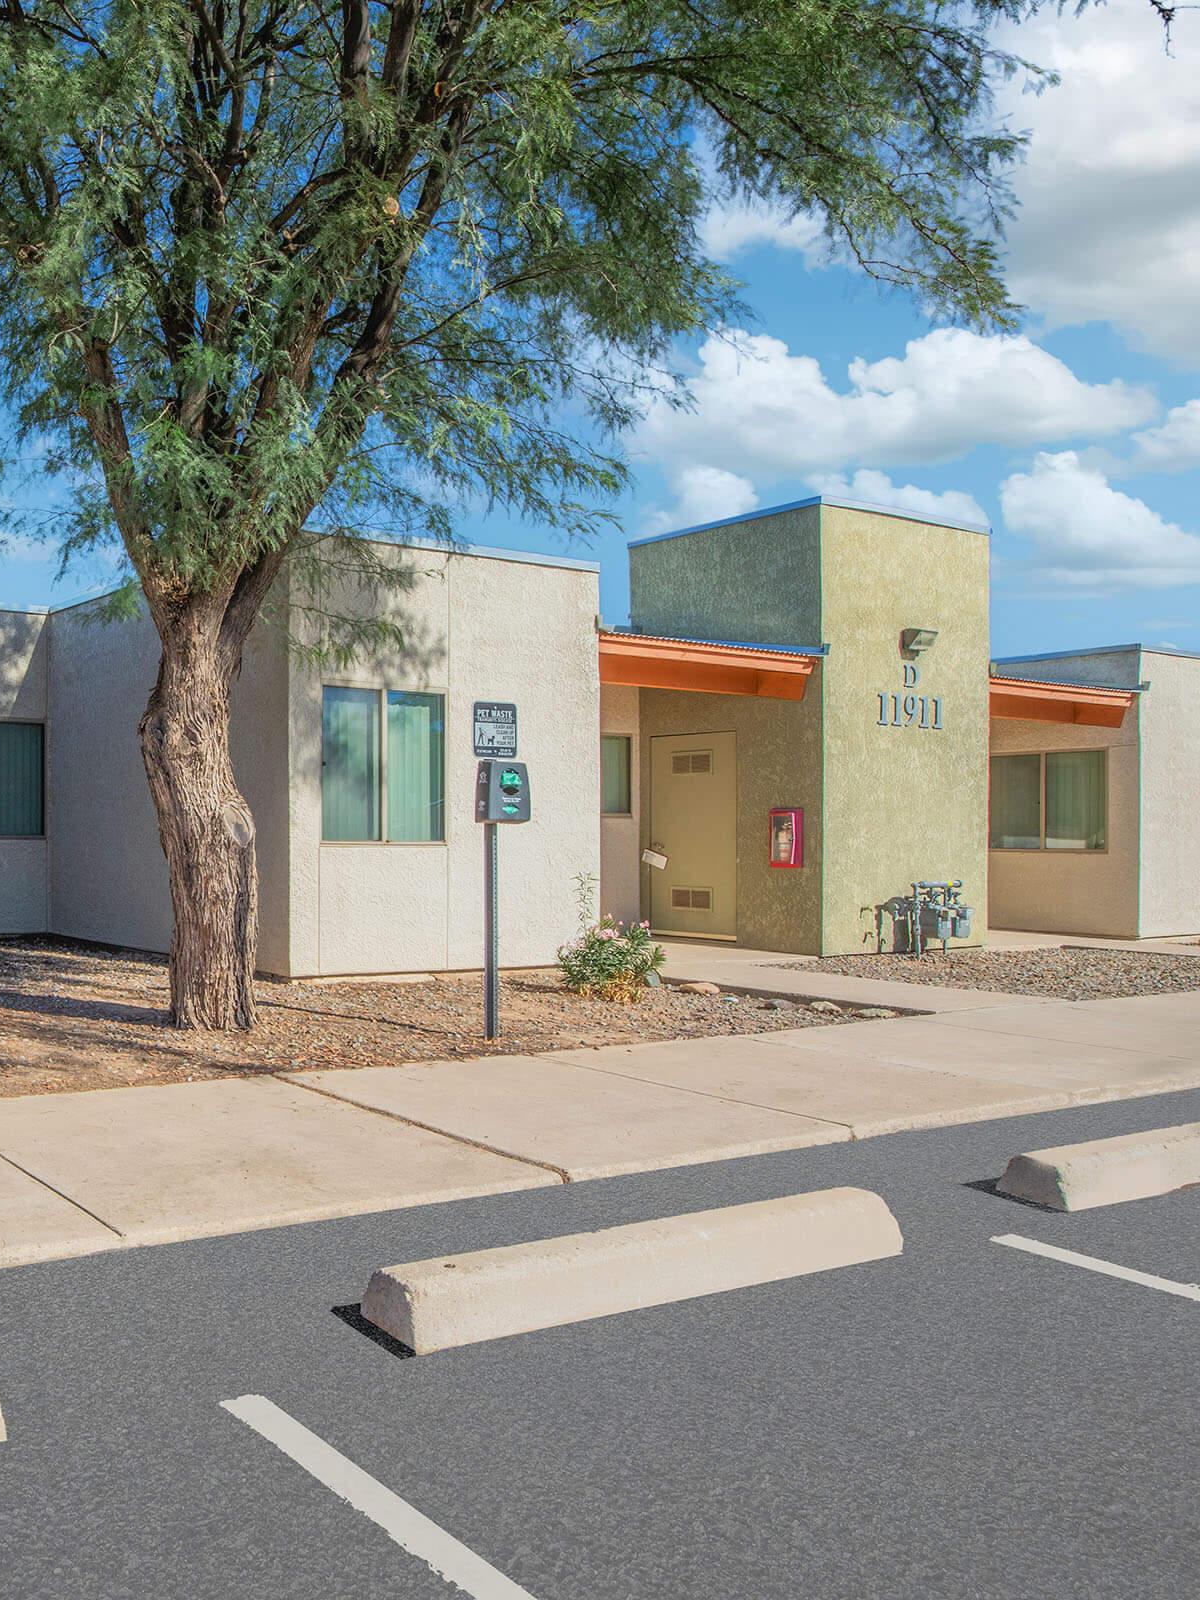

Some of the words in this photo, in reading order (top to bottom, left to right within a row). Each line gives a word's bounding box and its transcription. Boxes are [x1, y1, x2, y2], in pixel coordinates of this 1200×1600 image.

[903, 664, 920, 688] D
[477, 709, 489, 717] PET
[491, 709, 513, 718] WASTE
[876, 691, 944, 729] 11911
